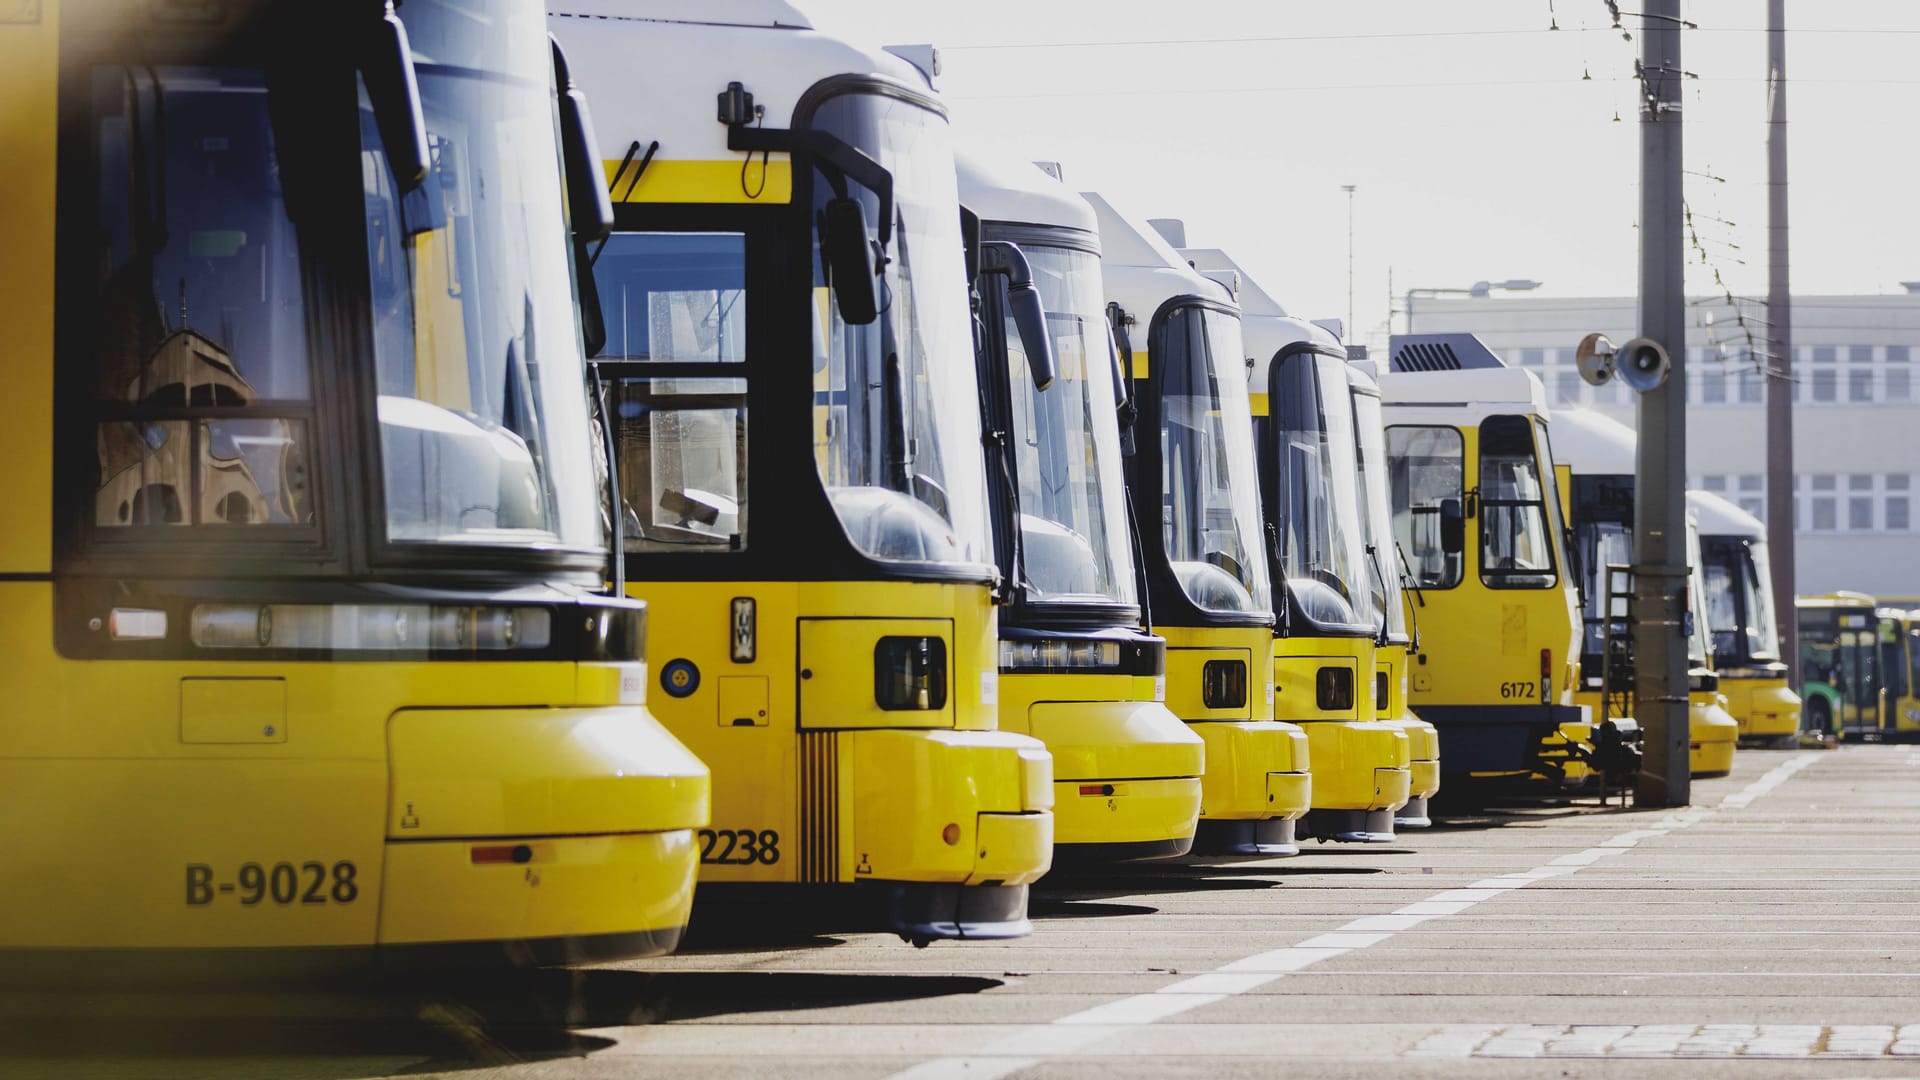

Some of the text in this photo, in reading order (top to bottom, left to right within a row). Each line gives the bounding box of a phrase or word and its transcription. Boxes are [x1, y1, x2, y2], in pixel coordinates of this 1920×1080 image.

[1501, 682, 1535, 698] 6172
[698, 829, 780, 865] 2238
[186, 861, 358, 905] B-9028
